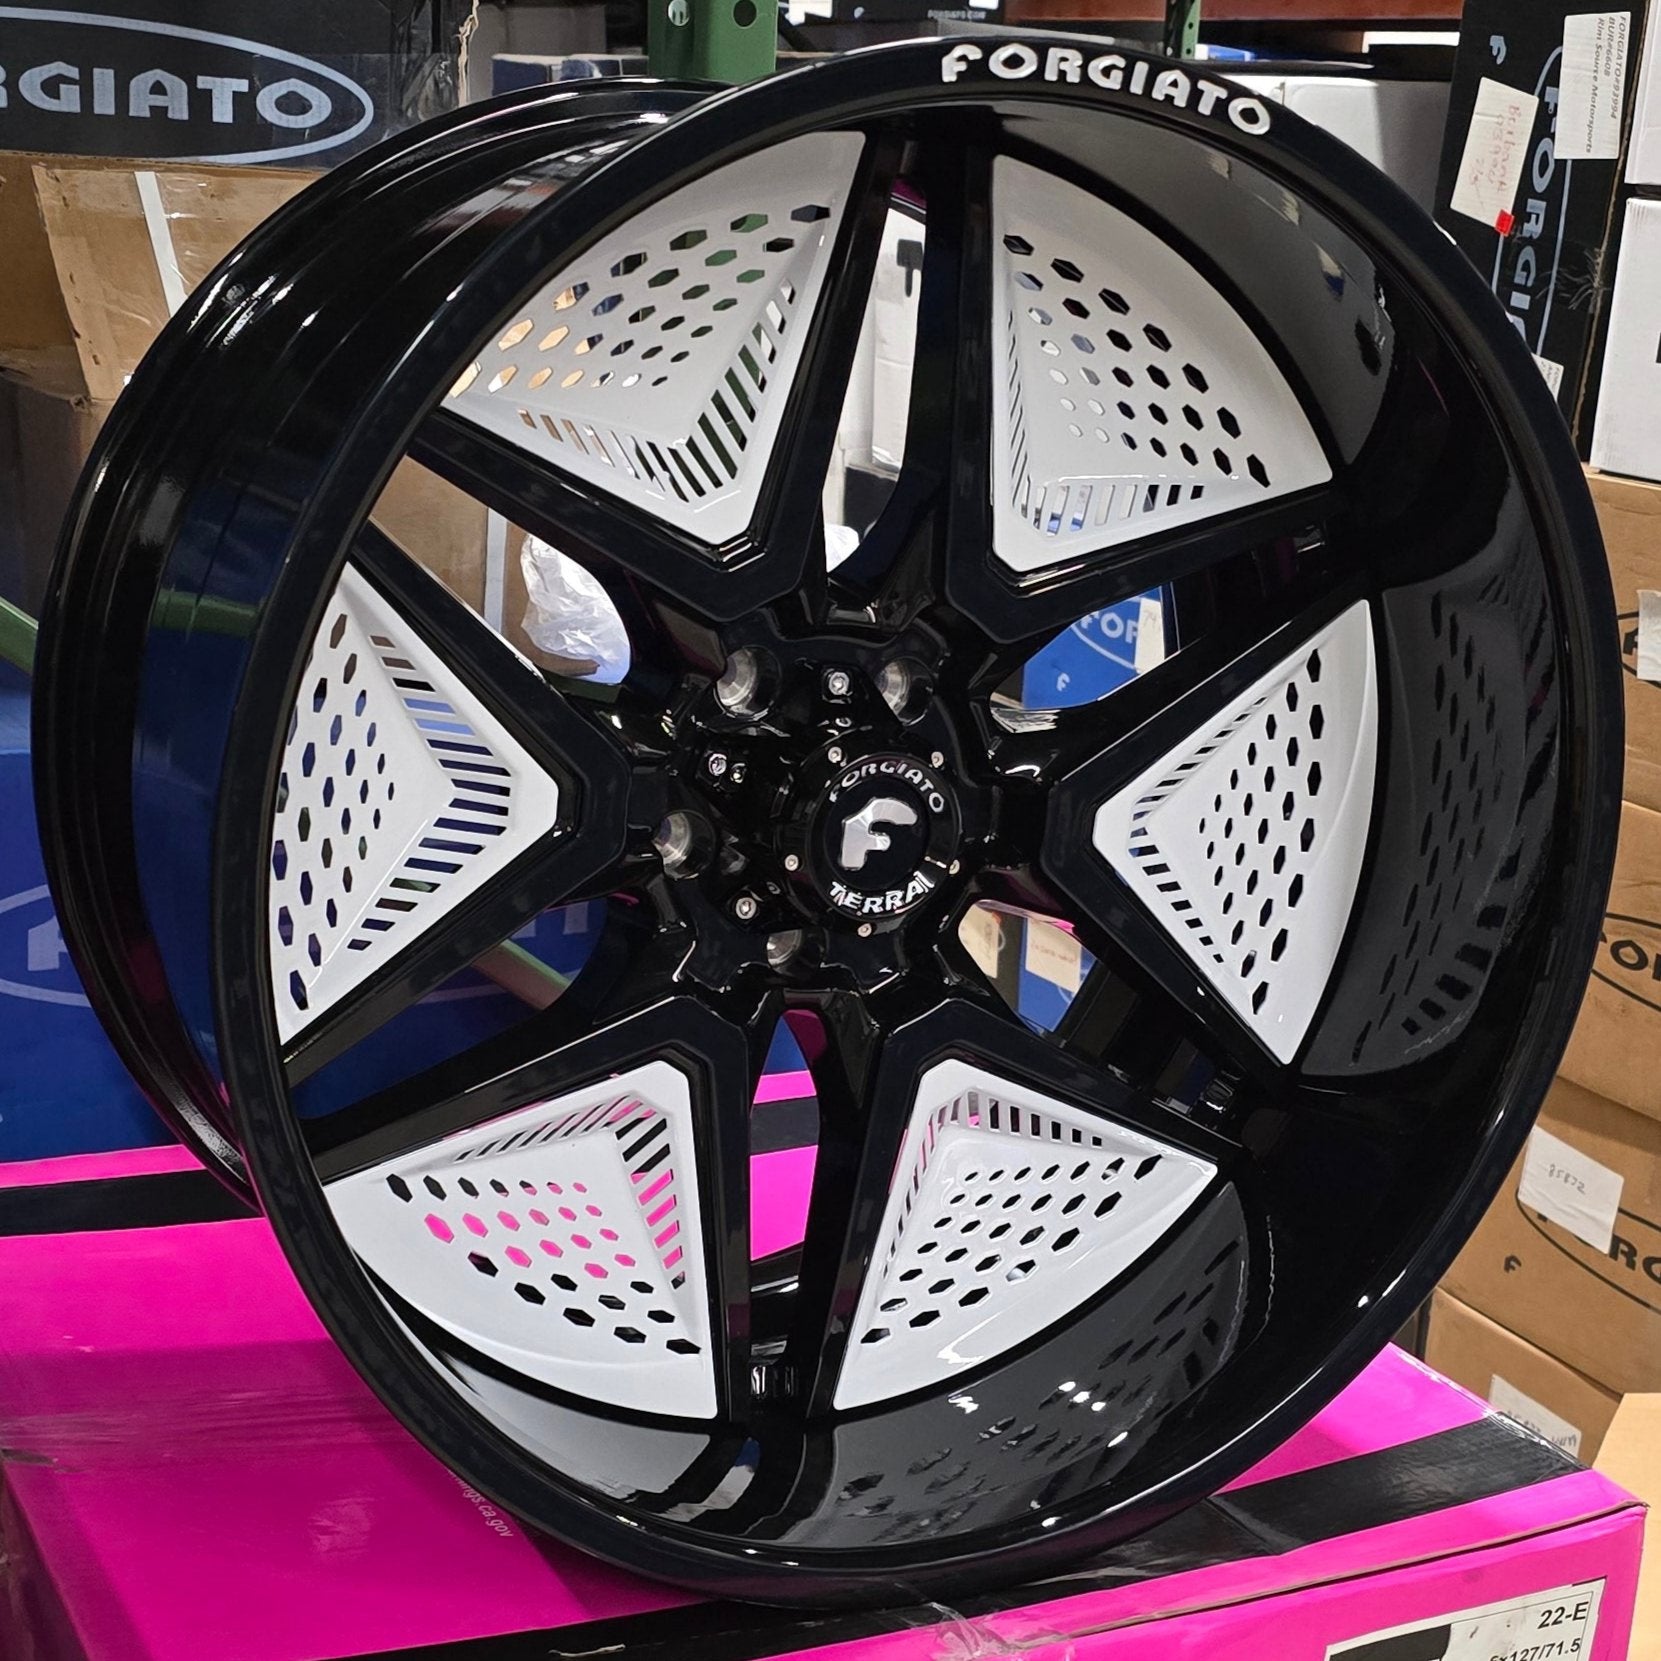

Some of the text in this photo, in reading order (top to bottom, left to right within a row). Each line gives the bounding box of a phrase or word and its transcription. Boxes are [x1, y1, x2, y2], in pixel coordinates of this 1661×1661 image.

[941, 43, 1271, 136] FORGIATO
[1592, 44, 1603, 82] Source
[0, 61, 332, 129] GIATO
[829, 761, 945, 814] FORGIATO
[841, 797, 918, 871] F
[1537, 1601, 1589, 1629] 22-E
